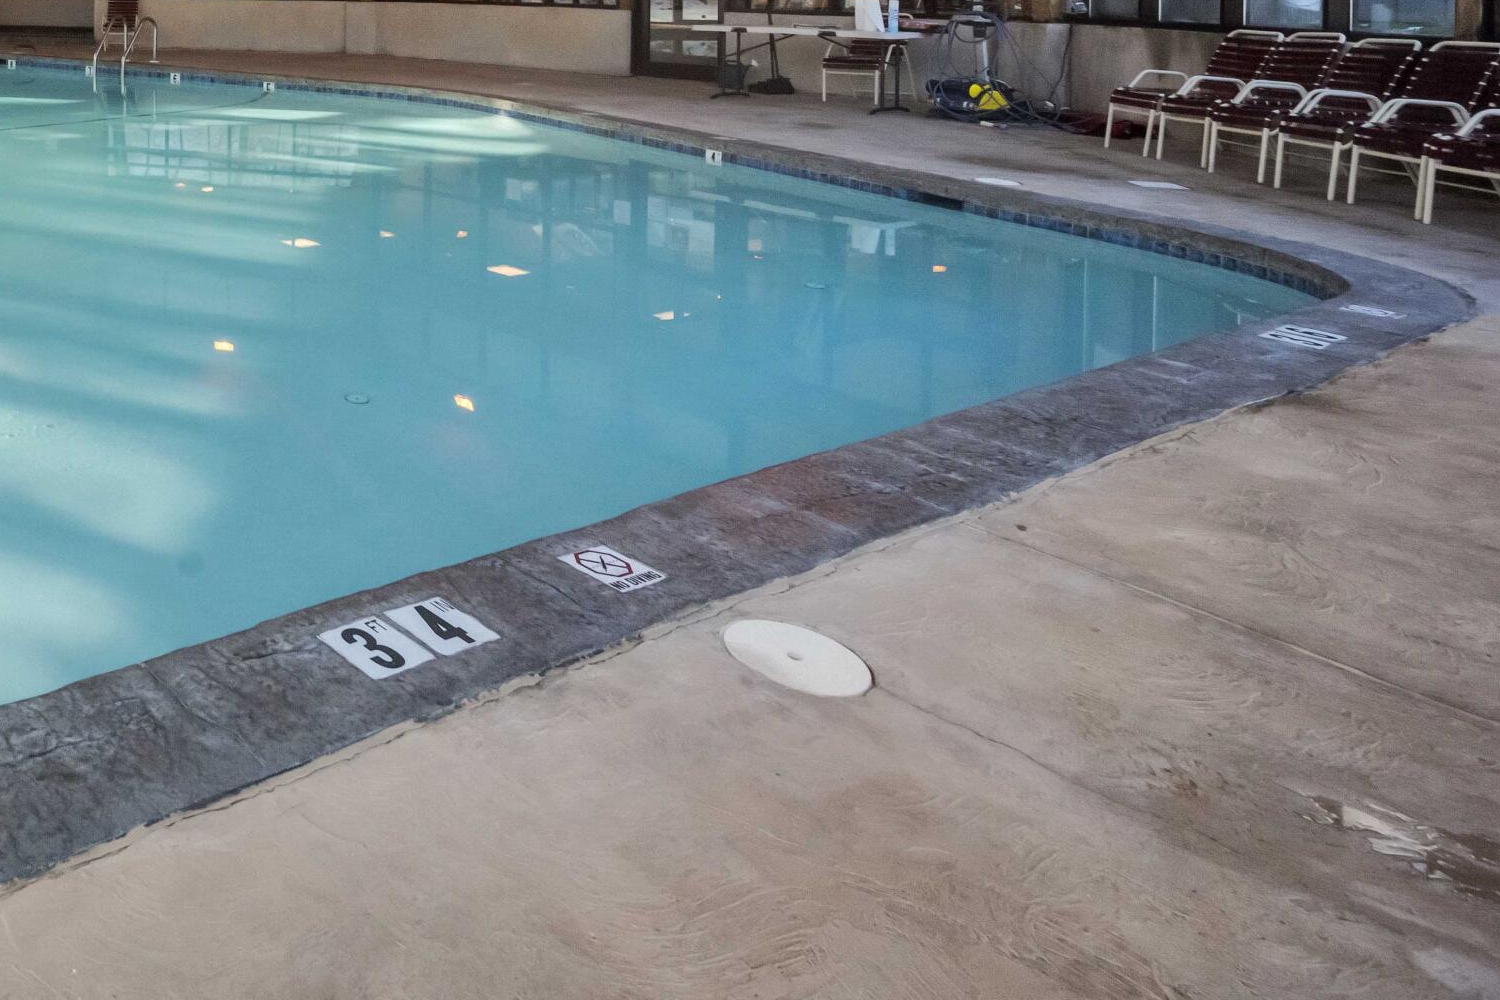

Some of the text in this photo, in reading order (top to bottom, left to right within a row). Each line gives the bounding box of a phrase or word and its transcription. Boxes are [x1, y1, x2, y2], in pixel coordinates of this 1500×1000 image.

[609, 571, 662, 590] NO DIVING
[364, 619, 388, 634] FT
[414, 605, 477, 644] 4
[341, 627, 406, 669] 3
